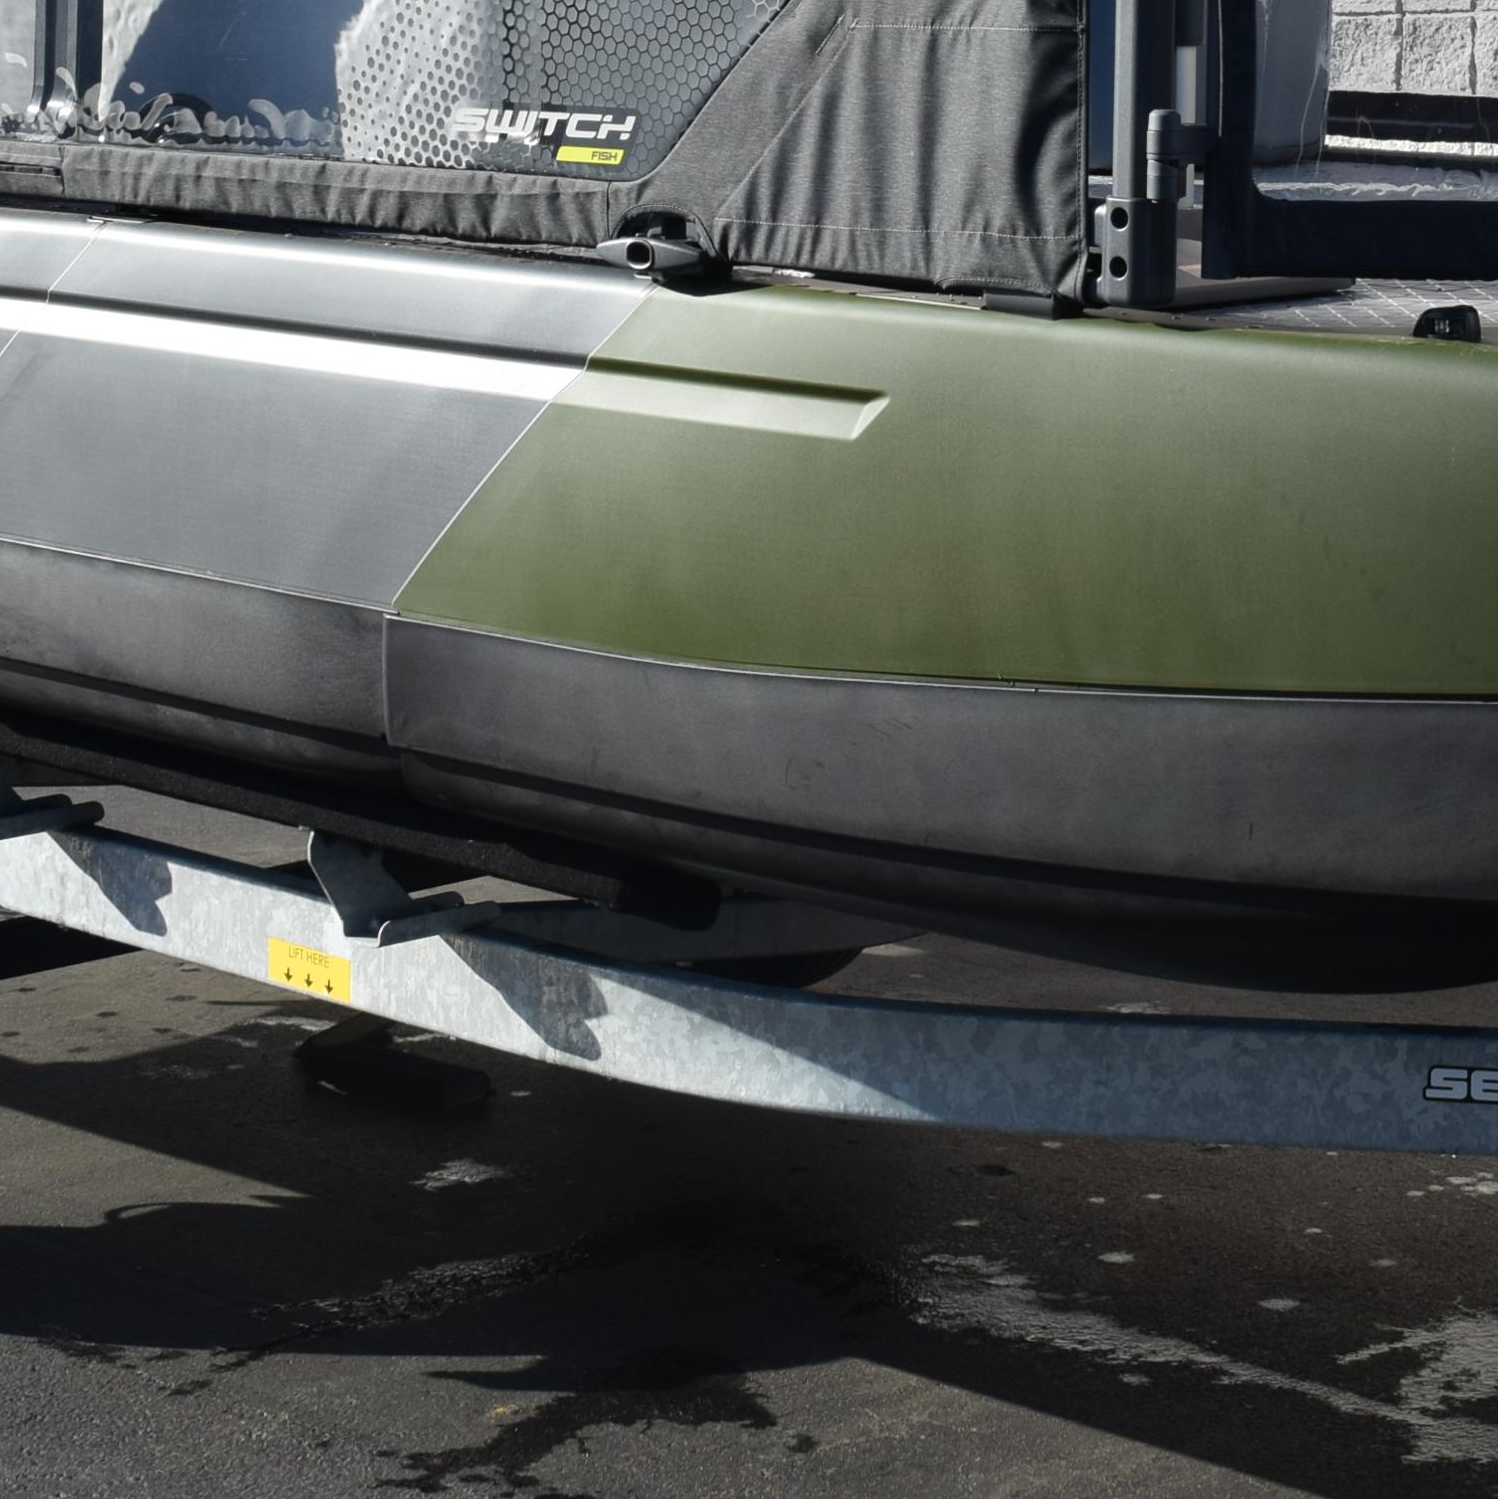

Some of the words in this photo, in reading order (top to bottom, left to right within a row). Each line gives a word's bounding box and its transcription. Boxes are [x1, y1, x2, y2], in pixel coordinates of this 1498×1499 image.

[452, 107, 636, 142] SWITCH
[591, 151, 618, 162] FISH
[288, 946, 304, 961] LIFT
[306, 950, 330, 969] HERE
